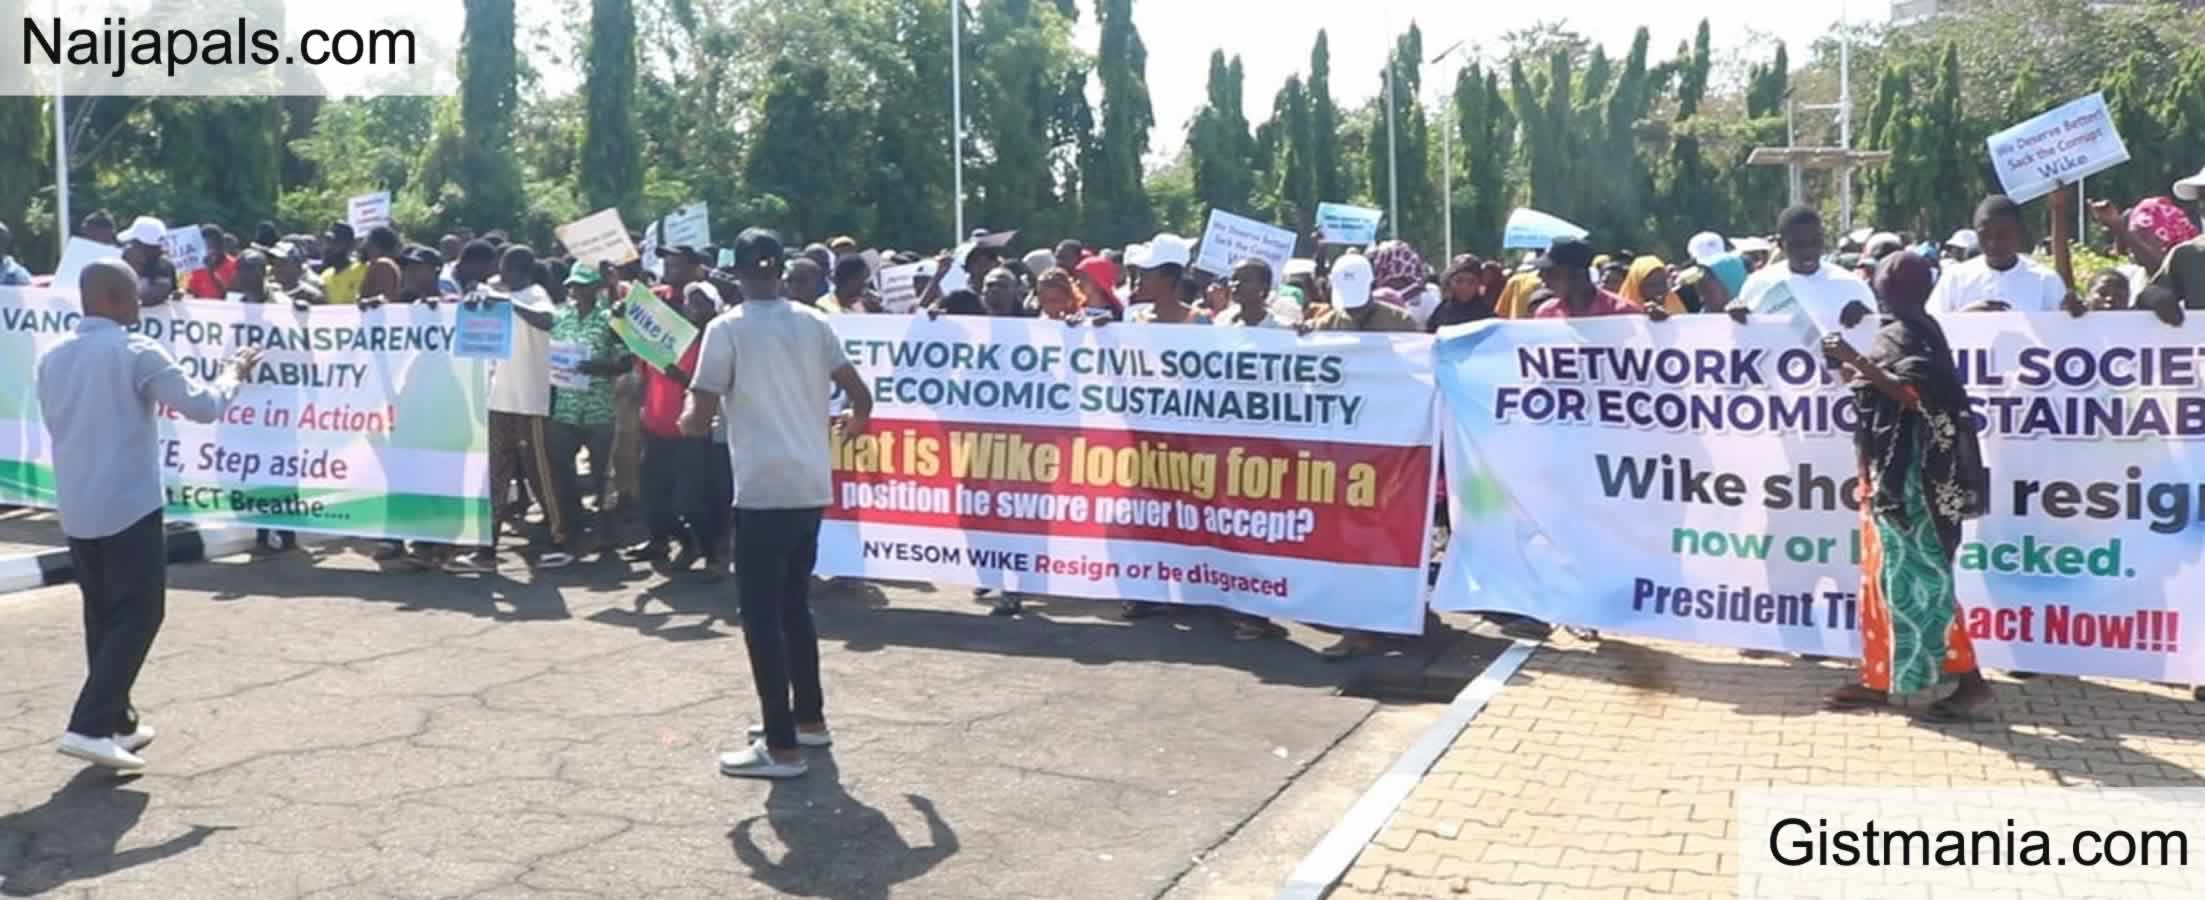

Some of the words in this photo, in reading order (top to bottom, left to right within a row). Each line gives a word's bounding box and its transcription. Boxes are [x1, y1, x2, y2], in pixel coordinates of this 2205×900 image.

[2036, 154, 2088, 178] Wike
[170, 319, 223, 345] FOR
[230, 322, 455, 351] TRANSPARENCY
[629, 303, 662, 338] Wike
[844, 339, 1000, 371] ETWORK
[1010, 344, 1061, 373] OF
[1070, 347, 1154, 377] CIVIL
[1160, 350, 1343, 383] SOCIETIES
[1517, 346, 1765, 386] NETWORK
[264, 400, 289, 427] in
[298, 402, 396, 433] Action!
[874, 376, 1071, 411] ECONOMIC
[1079, 384, 1361, 425] SUSTAINABILITY
[1494, 387, 1586, 422] FOR
[1597, 388, 1857, 433] ECONOMIC
[197, 442, 261, 481] Step
[269, 449, 347, 479] aside
[903, 428, 940, 477] is
[950, 430, 1061, 482] Wike
[1071, 436, 1217, 500] looking
[1226, 447, 1289, 499] for
[1298, 450, 1337, 504] in
[1347, 461, 1377, 508] a
[181, 485, 226, 510] FCT
[841, 480, 950, 514] position
[955, 484, 991, 516] he
[996, 489, 1088, 523] swore
[1095, 496, 1172, 528] never
[1177, 501, 1198, 531] to
[1203, 506, 1315, 543] accept?
[1595, 453, 1747, 506] Wike
[2012, 465, 2205, 534] resig
[862, 540, 961, 566] NYESOM
[967, 547, 1029, 572] WIKE
[1034, 555, 1120, 582] Resign
[1126, 563, 1153, 579] or
[1157, 561, 1183, 583] be
[1186, 563, 1289, 597] disgraced
[1671, 527, 1773, 561] now
[1784, 535, 1837, 564] or
[1959, 535, 2137, 578] acked.
[1632, 577, 1815, 627] President
[1967, 604, 2034, 643] act
[2043, 603, 2180, 653] Now!!!
